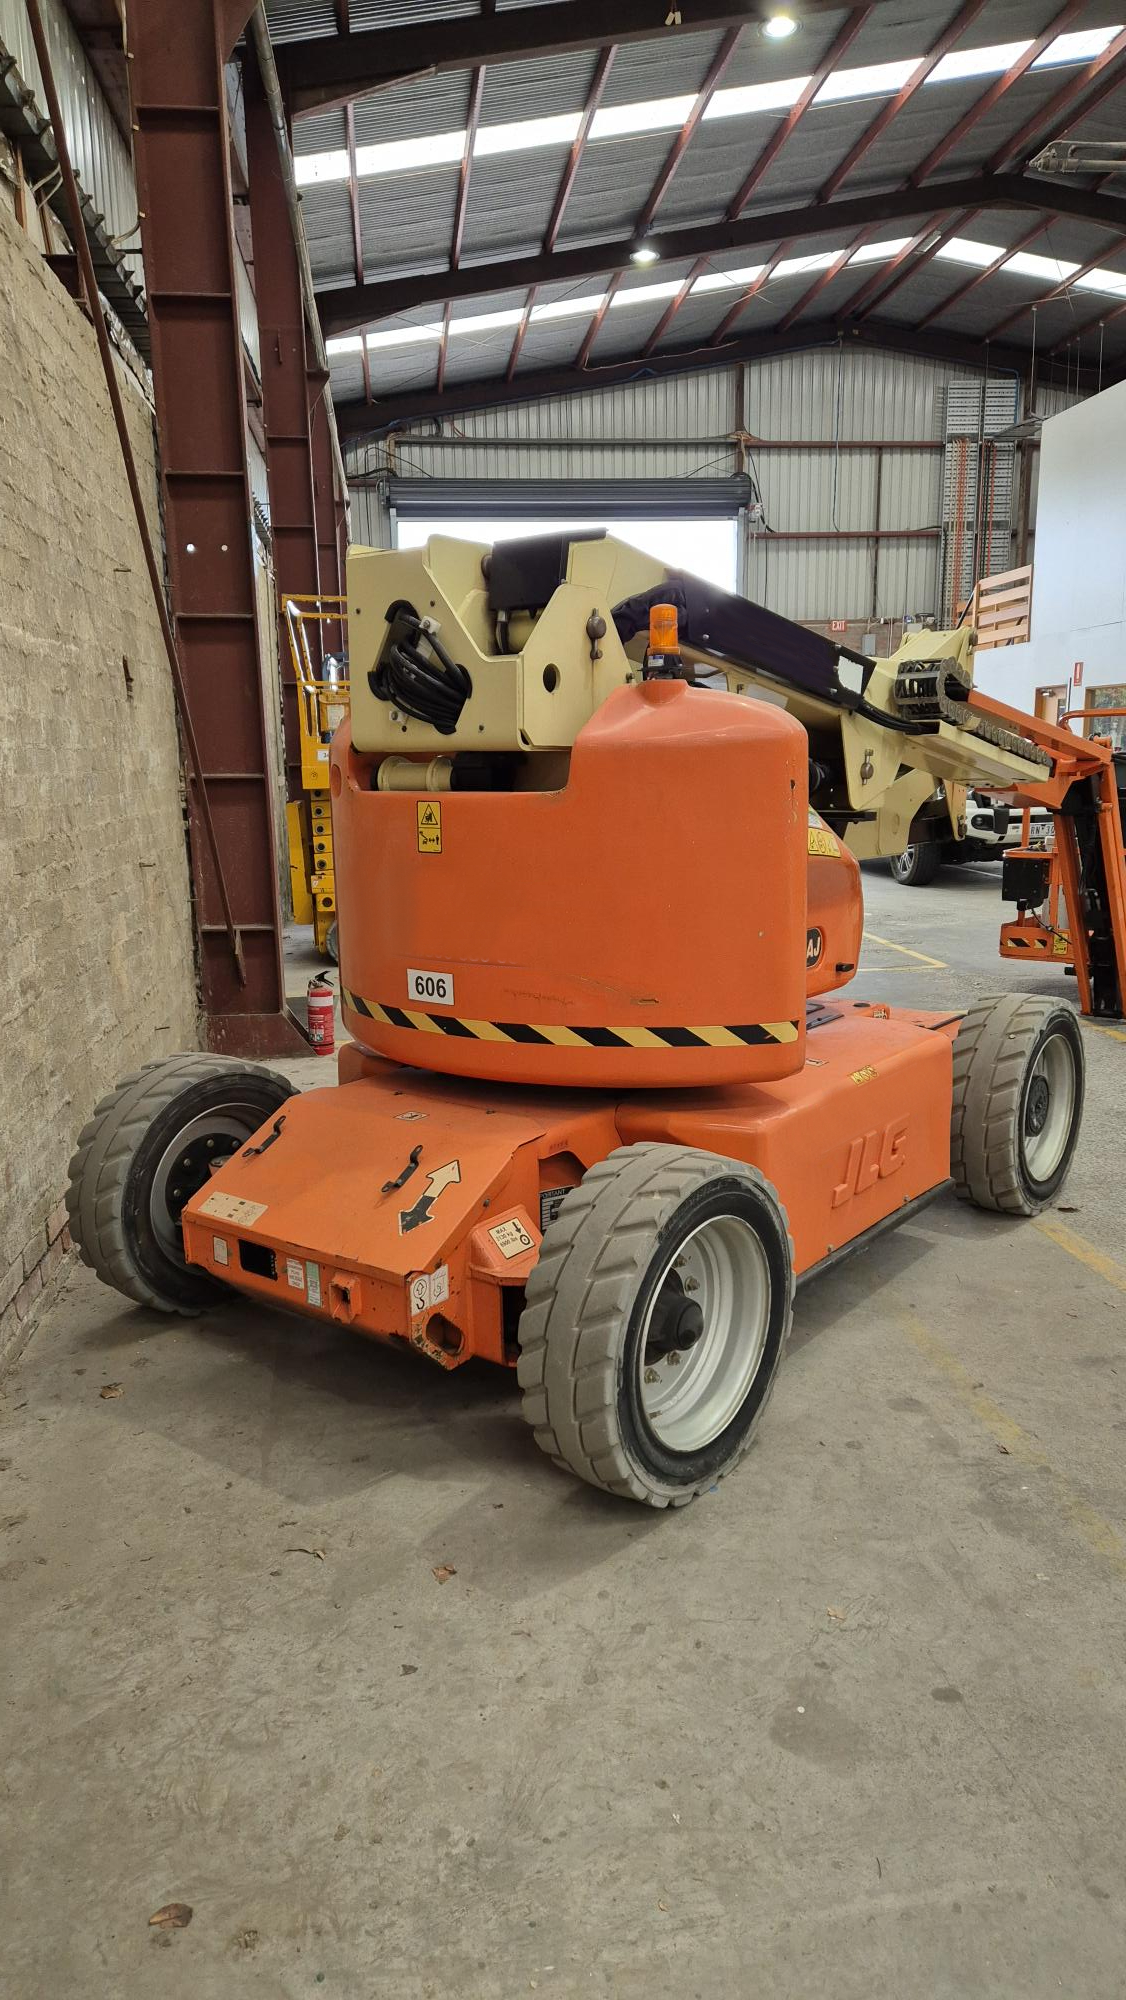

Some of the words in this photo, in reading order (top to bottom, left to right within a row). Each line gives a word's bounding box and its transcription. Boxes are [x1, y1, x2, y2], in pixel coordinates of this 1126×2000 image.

[832, 620, 845, 631] EXIT
[415, 975, 447, 998] 606
[831, 1111, 911, 1209] JLG
